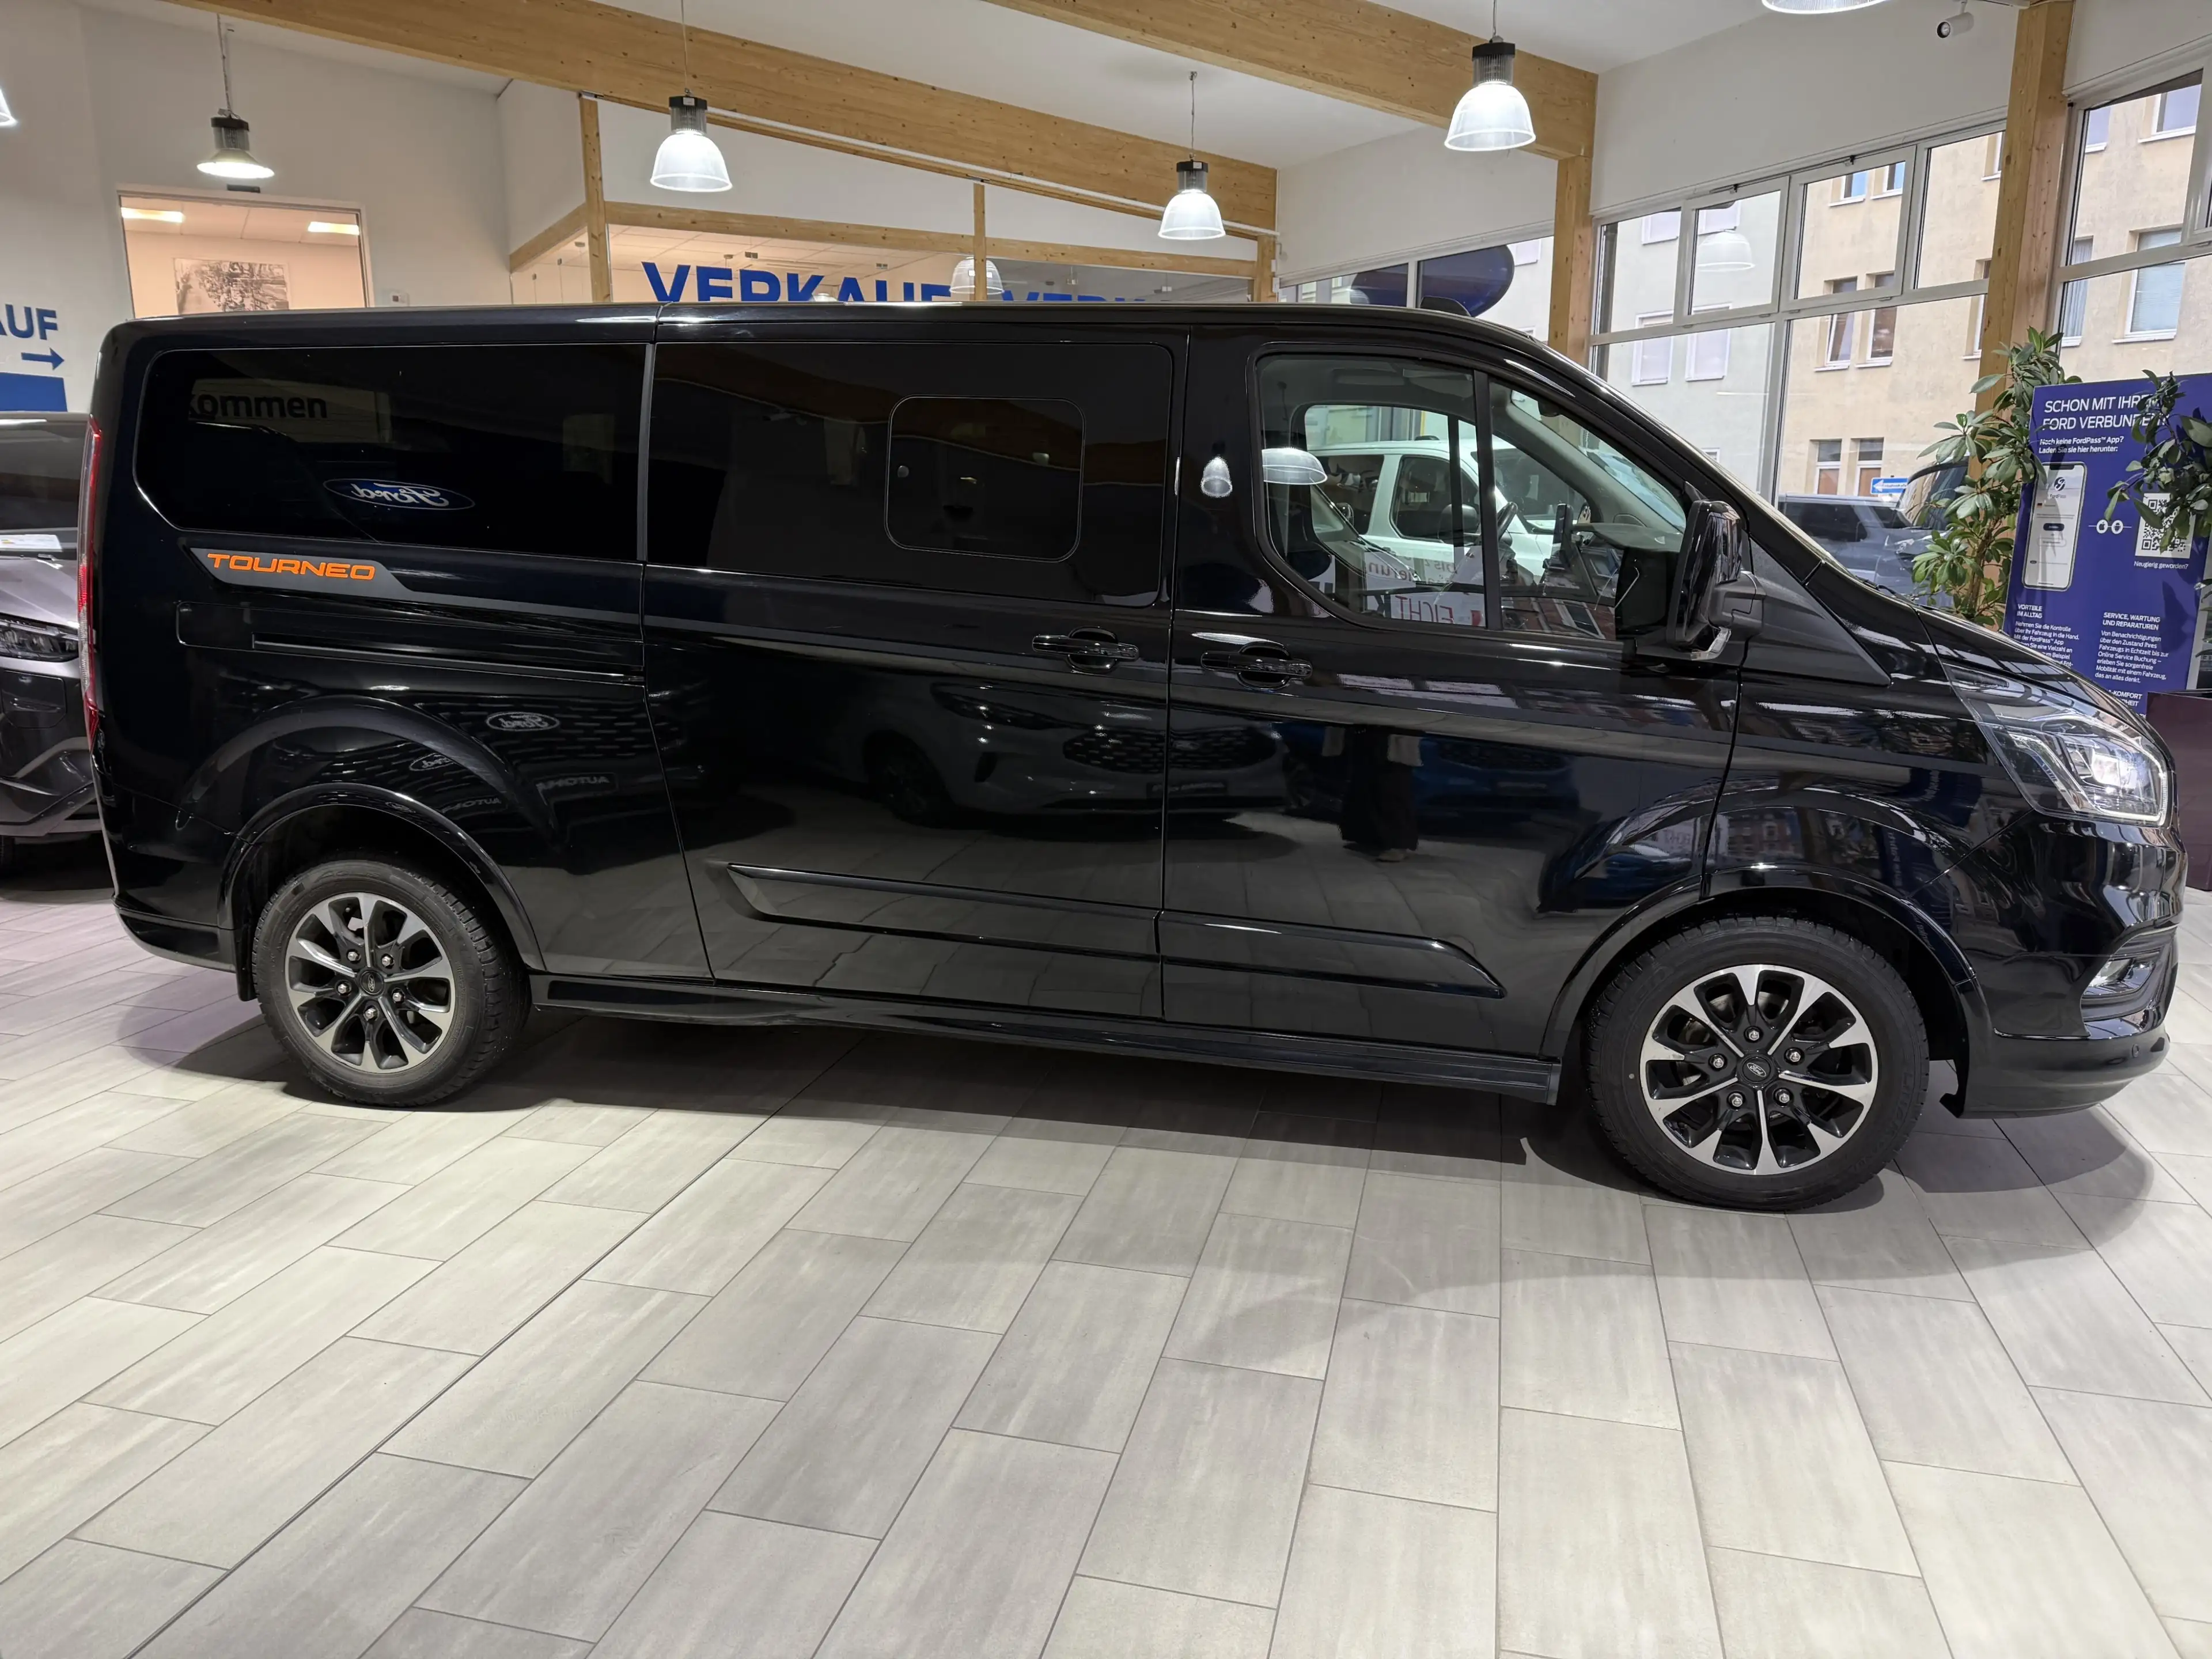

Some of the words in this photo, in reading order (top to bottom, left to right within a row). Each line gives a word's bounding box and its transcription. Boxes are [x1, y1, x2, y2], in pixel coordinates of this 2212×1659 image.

[0, 304, 58, 340] UF
[2044, 399, 2088, 413] SCHON
[2092, 396, 2116, 411] MIT
[2118, 394, 2160, 409] IHR
[2043, 416, 2076, 430] FORD
[2107, 436, 2124, 444] App?
[207, 553, 376, 581] TOURNEO
[2104, 612, 2129, 620] SERVICE,
[2130, 614, 2160, 623] WARTUNG
[2116, 621, 2159, 630] REPARATUREN
[2032, 630, 2052, 638] Fahrzeug
[2112, 631, 2161, 642] Benachrichtigungen
[2099, 645, 2124, 653] Fahrzeugs
[2131, 647, 2151, 656] Echtzeit
[2134, 656, 2157, 664] Buchung
